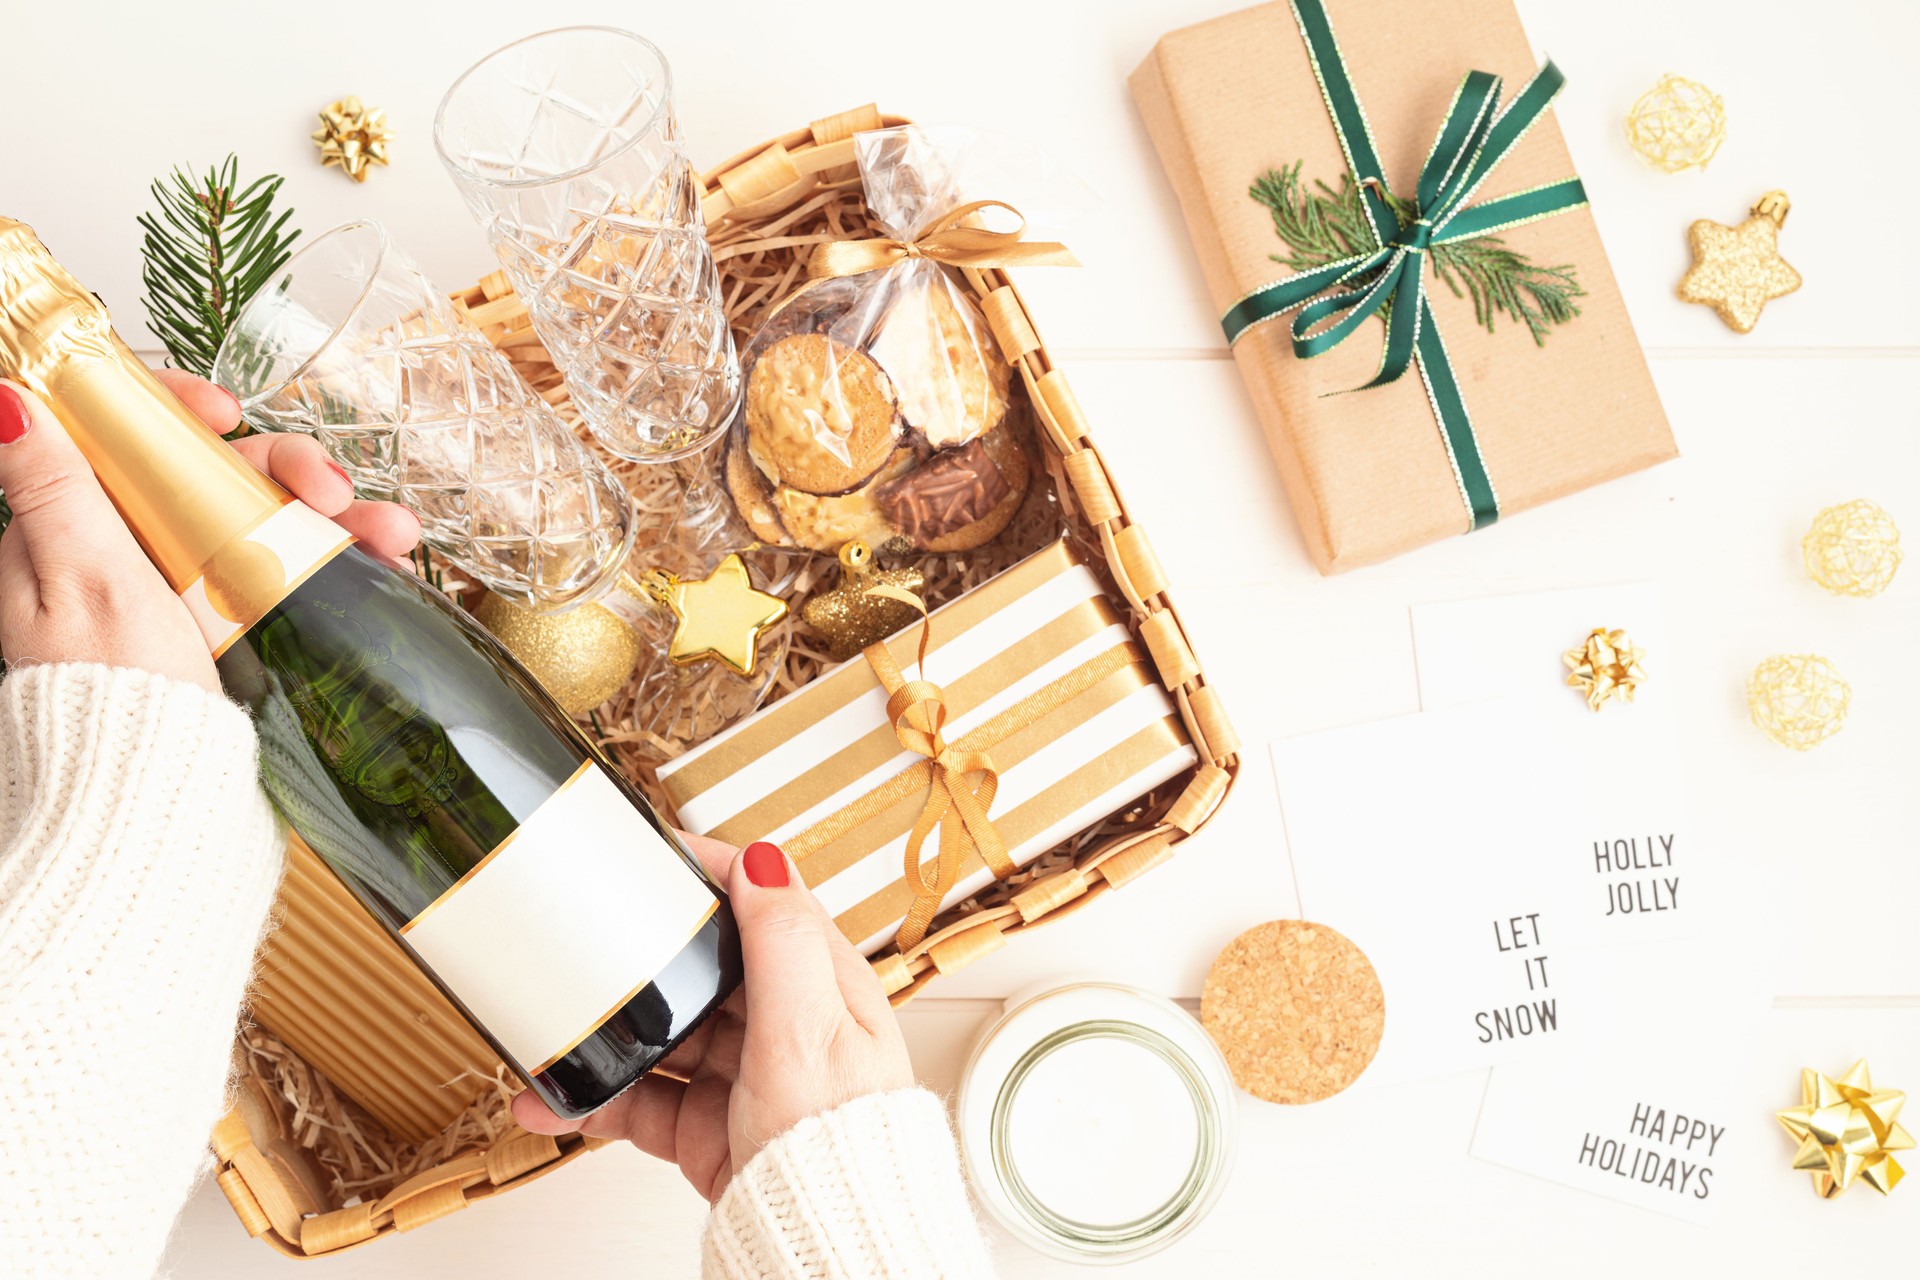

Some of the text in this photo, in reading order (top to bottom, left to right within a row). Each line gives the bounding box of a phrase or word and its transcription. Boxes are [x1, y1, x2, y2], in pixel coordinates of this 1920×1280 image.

[1593, 834, 1674, 873] HOLLY
[1606, 877, 1679, 916] JOLLY
[1493, 913, 1540, 952] LET
[1524, 955, 1548, 991] IT
[1475, 998, 1557, 1044] SNOW
[1629, 1102, 1725, 1157] HAPPY
[1578, 1132, 1713, 1200] HOLIDAYS
